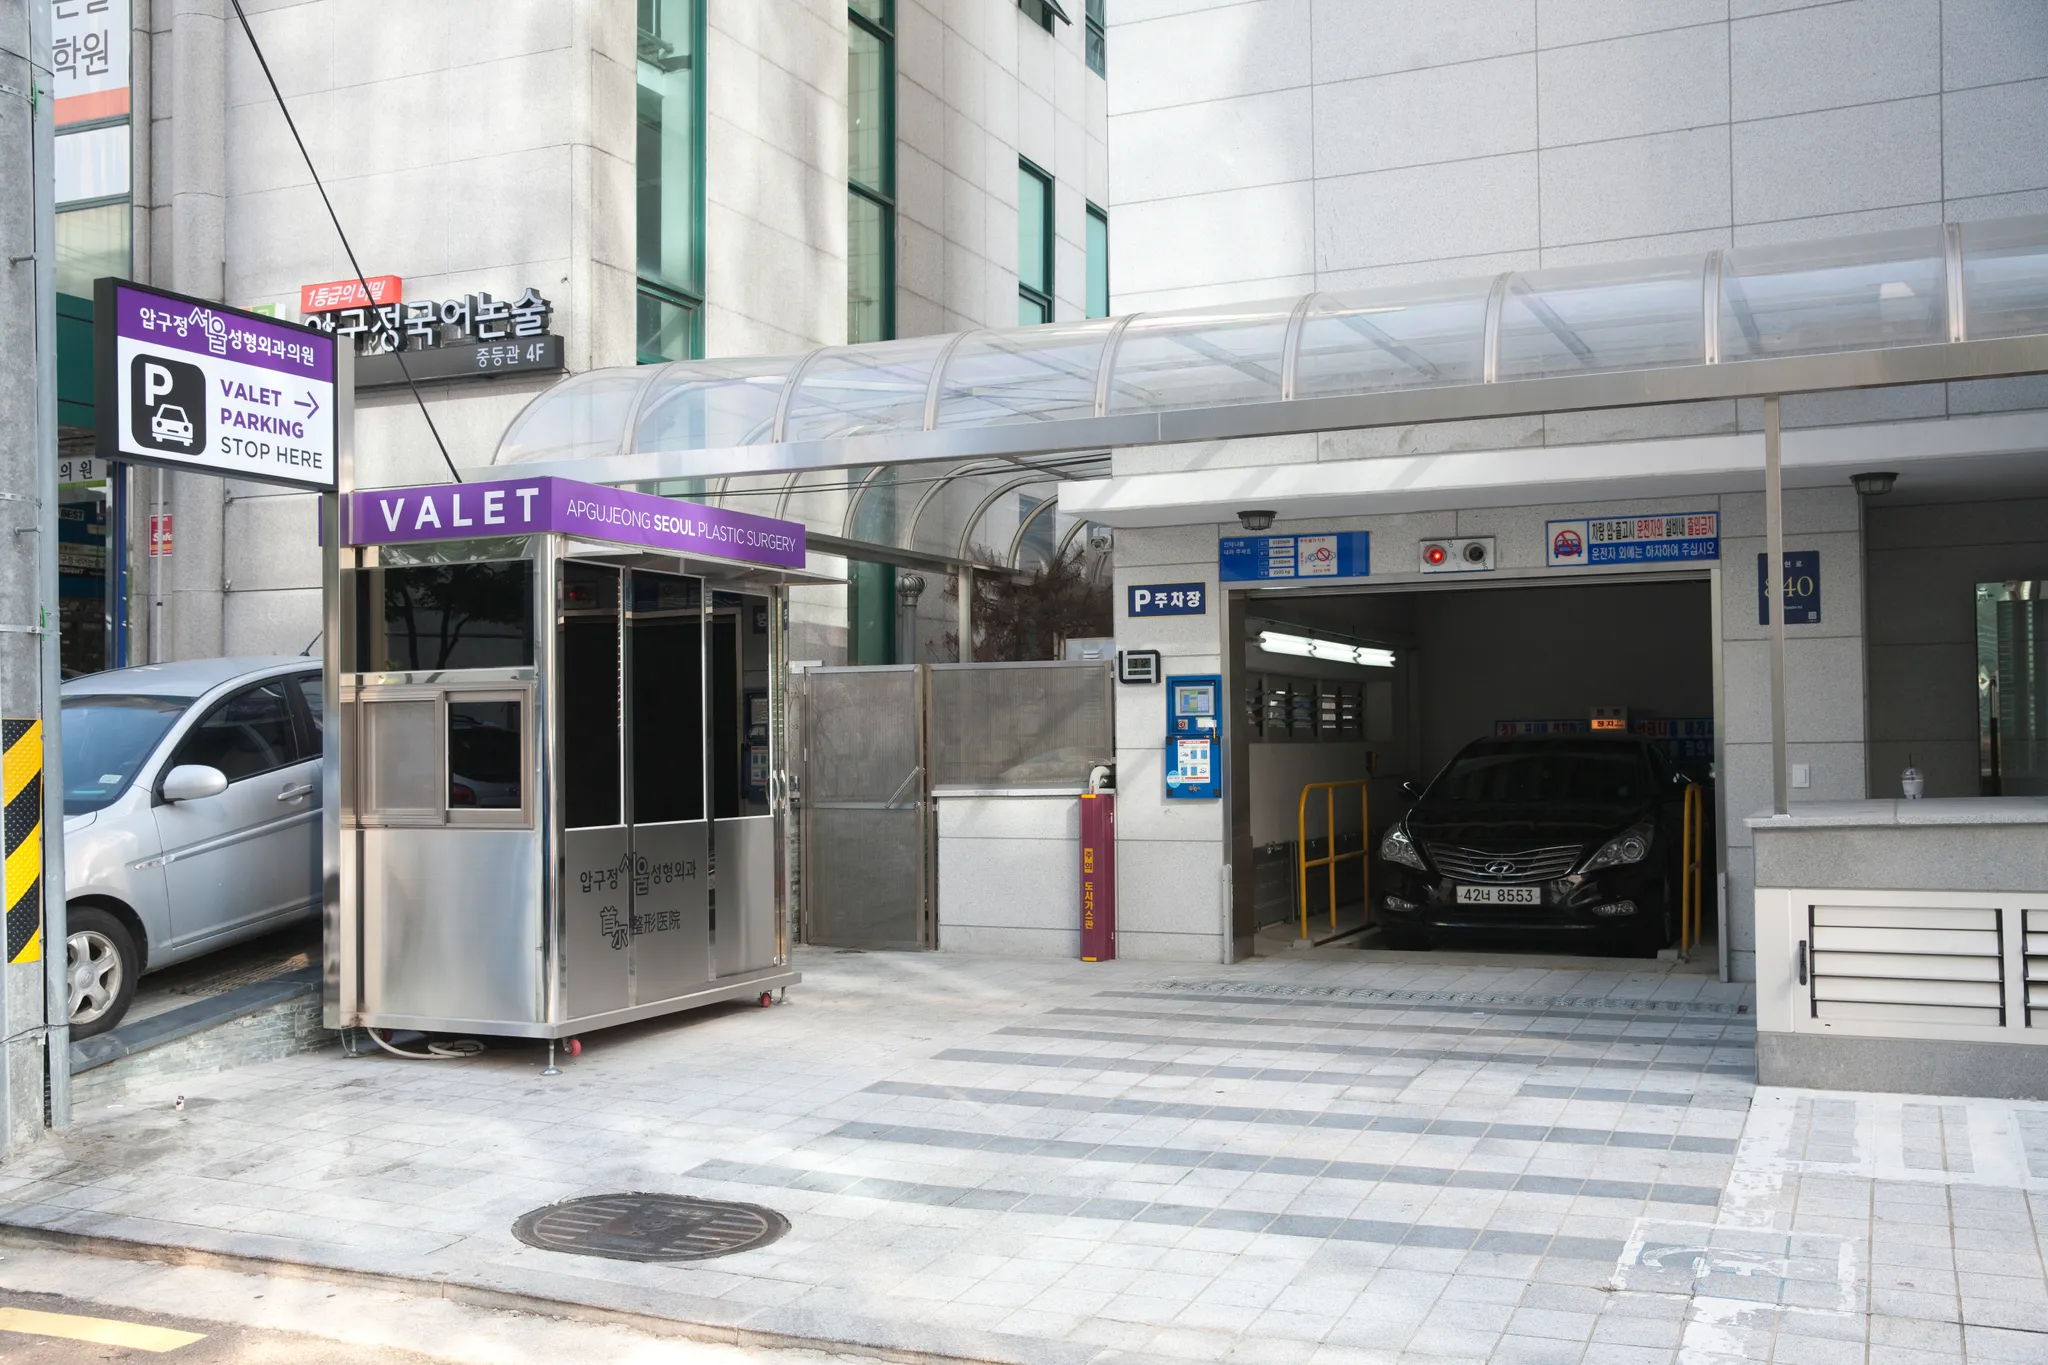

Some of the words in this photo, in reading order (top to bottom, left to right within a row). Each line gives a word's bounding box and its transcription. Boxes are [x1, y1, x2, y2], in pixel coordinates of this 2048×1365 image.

[52, 29, 109, 79] 학원
[308, 286, 353, 306] 1등급의
[357, 280, 386, 300] 비밀
[476, 345, 520, 368] 중등관
[526, 342, 545, 363] 4F
[144, 362, 174, 407] P
[219, 378, 283, 407] VALET
[220, 407, 305, 439] PARKING
[221, 436, 271, 460] STOP
[276, 445, 323, 470] HERE
[379, 486, 540, 532] VALET
[566, 499, 651, 530] APGUJEONG
[654, 514, 696, 537] SEOUL
[698, 521, 745, 545] PLASTIC
[747, 529, 797, 553] SURGERY
[1592, 522, 1605, 541] 차량
[1637, 518, 1664, 539] 운전자외
[1665, 517, 1686, 537] 설비내
[1687, 515, 1715, 536] 출입금지
[1592, 547, 1616, 560] 운전자
[1618, 545, 1643, 559] 외에는
[1645, 543, 1679, 558] 하차하여
[1681, 541, 1715, 556] 주십시오
[1134, 589, 1151, 612] P
[1154, 591, 1201, 609] 주차장
[1084, 851, 1093, 870] 주의
[1084, 881, 1094, 930] 도시가스관
[1463, 888, 1491, 902] 42너
[1497, 888, 1533, 903] 8553
